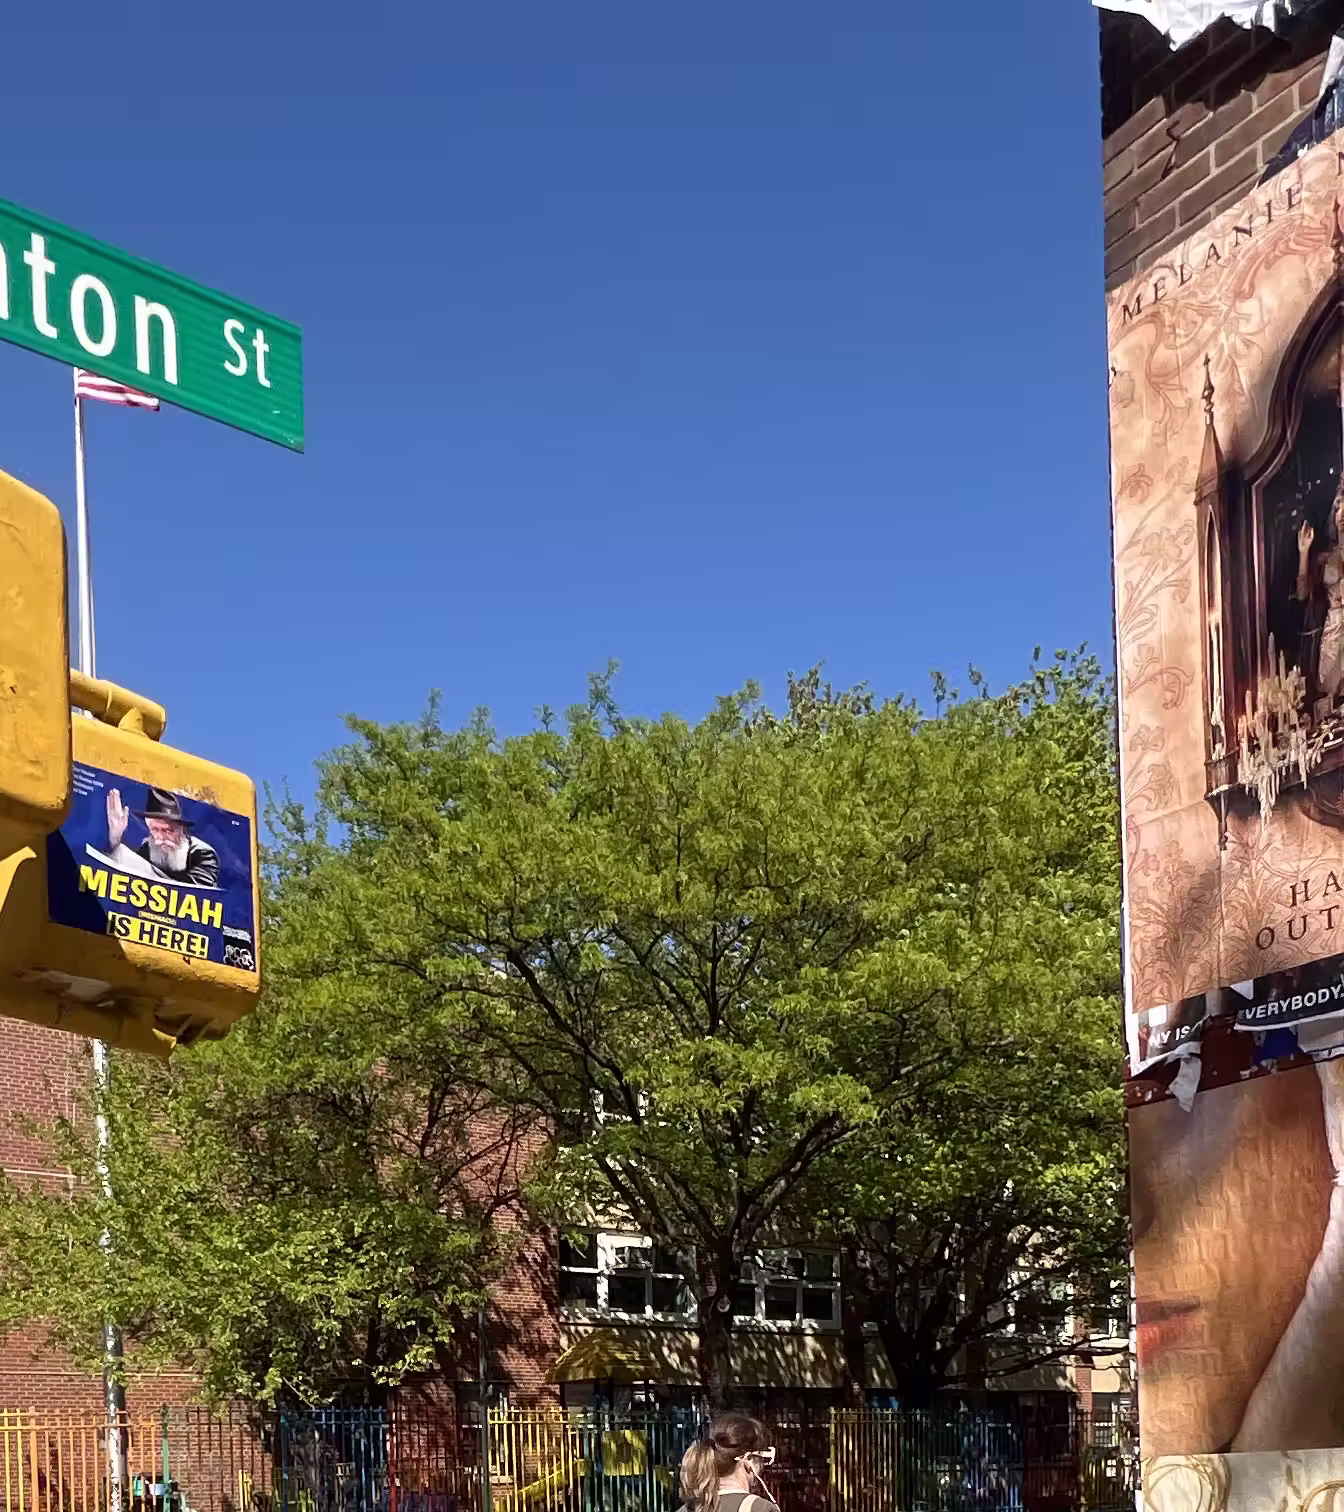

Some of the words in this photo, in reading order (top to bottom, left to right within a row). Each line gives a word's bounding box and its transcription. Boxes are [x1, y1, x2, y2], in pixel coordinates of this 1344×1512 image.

[1120, 180, 1304, 328] MELANIE
[222, 317, 272, 388] St
[78, 864, 224, 929] MESSIAH
[109, 913, 132, 938] IS
[138, 924, 208, 956] HERE!
[1255, 904, 1341, 951] OUT
[1175, 1025, 1191, 1041] IS
